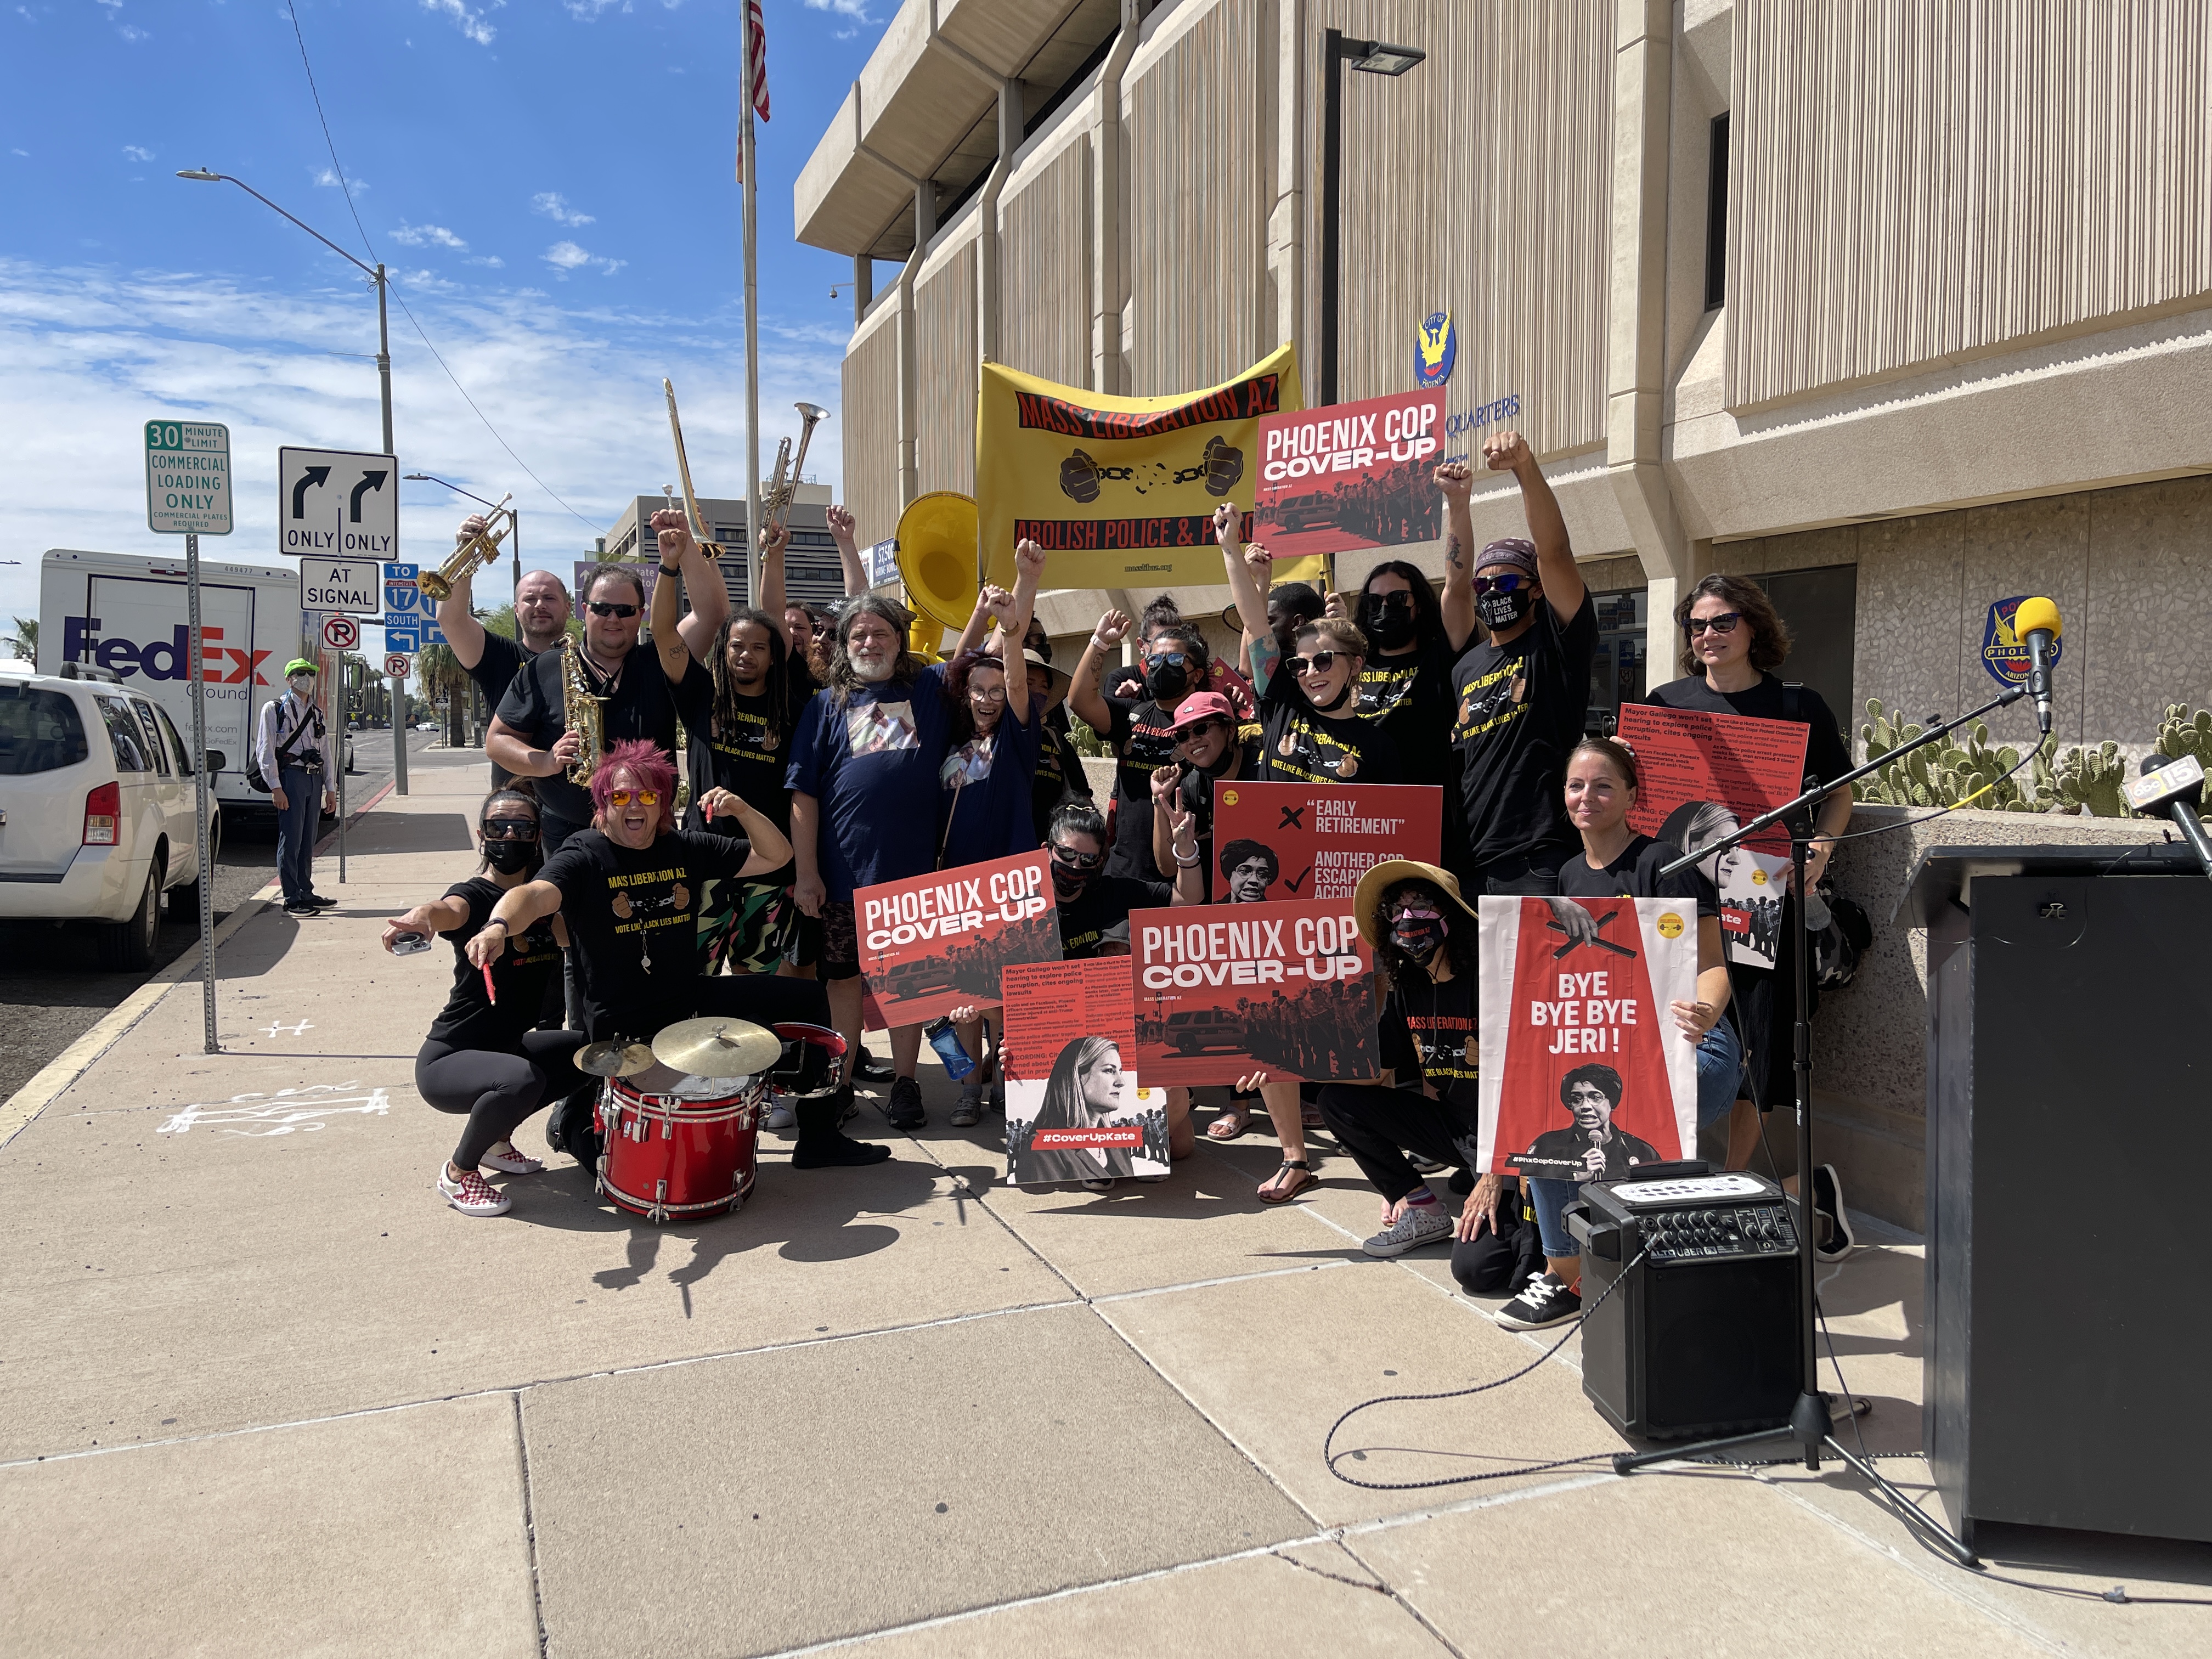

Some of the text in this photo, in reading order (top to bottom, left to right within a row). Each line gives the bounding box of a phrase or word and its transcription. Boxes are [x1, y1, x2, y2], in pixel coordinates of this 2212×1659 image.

[1425, 313, 1444, 329] CITY OF
[1422, 373, 1445, 390] PHOENIX
[1019, 376, 1278, 438] MASS LIBERATION AZ
[150, 425, 178, 447] 30
[185, 427, 223, 437] MINUTE
[1266, 403, 1436, 461] PHOENIX COP
[192, 439, 217, 448] LIMIT
[152, 455, 225, 471] COMMERCIAL
[1263, 437, 1436, 481] COVER-UP
[158, 474, 221, 490] LOADING
[166, 493, 213, 510] ONLY
[288, 529, 334, 548] ONLY
[1017, 521, 1097, 549] ABOLISH
[1105, 518, 1170, 548] POLICE
[1177, 518, 1194, 546] &
[346, 533, 391, 551] ONLY
[224, 566, 253, 574] 449477
[329, 568, 351, 583] AT
[392, 566, 410, 576] TO
[1124, 563, 1172, 573] masslibaz.org
[307, 588, 373, 605] SIGNAL
[392, 589, 413, 606] 17
[1492, 596, 1512, 607] BLACK
[1494, 605, 1511, 615] LIVES
[1496, 611, 1517, 623] MATTER
[387, 616, 418, 625] SOUTH
[64, 616, 273, 686] FedEx
[2006, 670, 2030, 679] ARIZON
[1494, 713, 1510, 725] LIVES
[1624, 716, 1651, 725] hearing
[1625, 708, 1647, 716] Mayor
[1650, 710, 1677, 720] Gallego
[1622, 732, 1651, 741] lawsuits
[1623, 725, 1662, 735] corruption,
[1683, 732, 1712, 741] ongoing
[725, 746, 741, 756] BLACK
[741, 751, 755, 759] LIVES
[756, 753, 776, 763] MATTER
[1284, 763, 1297, 774] LIKE
[2134, 762, 2194, 796] abc 15
[1314, 851, 1375, 868] ANOTHER
[676, 867, 687, 879] AZ
[865, 865, 1042, 931] PHOENIX COP
[615, 924, 630, 934] VOTE
[866, 896, 1046, 950] COVER-UP
[1143, 916, 1359, 964] PHOENIX COP
[1142, 955, 1362, 989] COVER-UP
[1559, 971, 1607, 998] BYE
[1531, 999, 1637, 1026] BYE BYE
[1435, 1068, 1453, 1076] BLACK
[1042, 1132, 1135, 1143] #CoverUpKate
[1513, 1156, 1583, 1167] #PhxCopCoverUp
